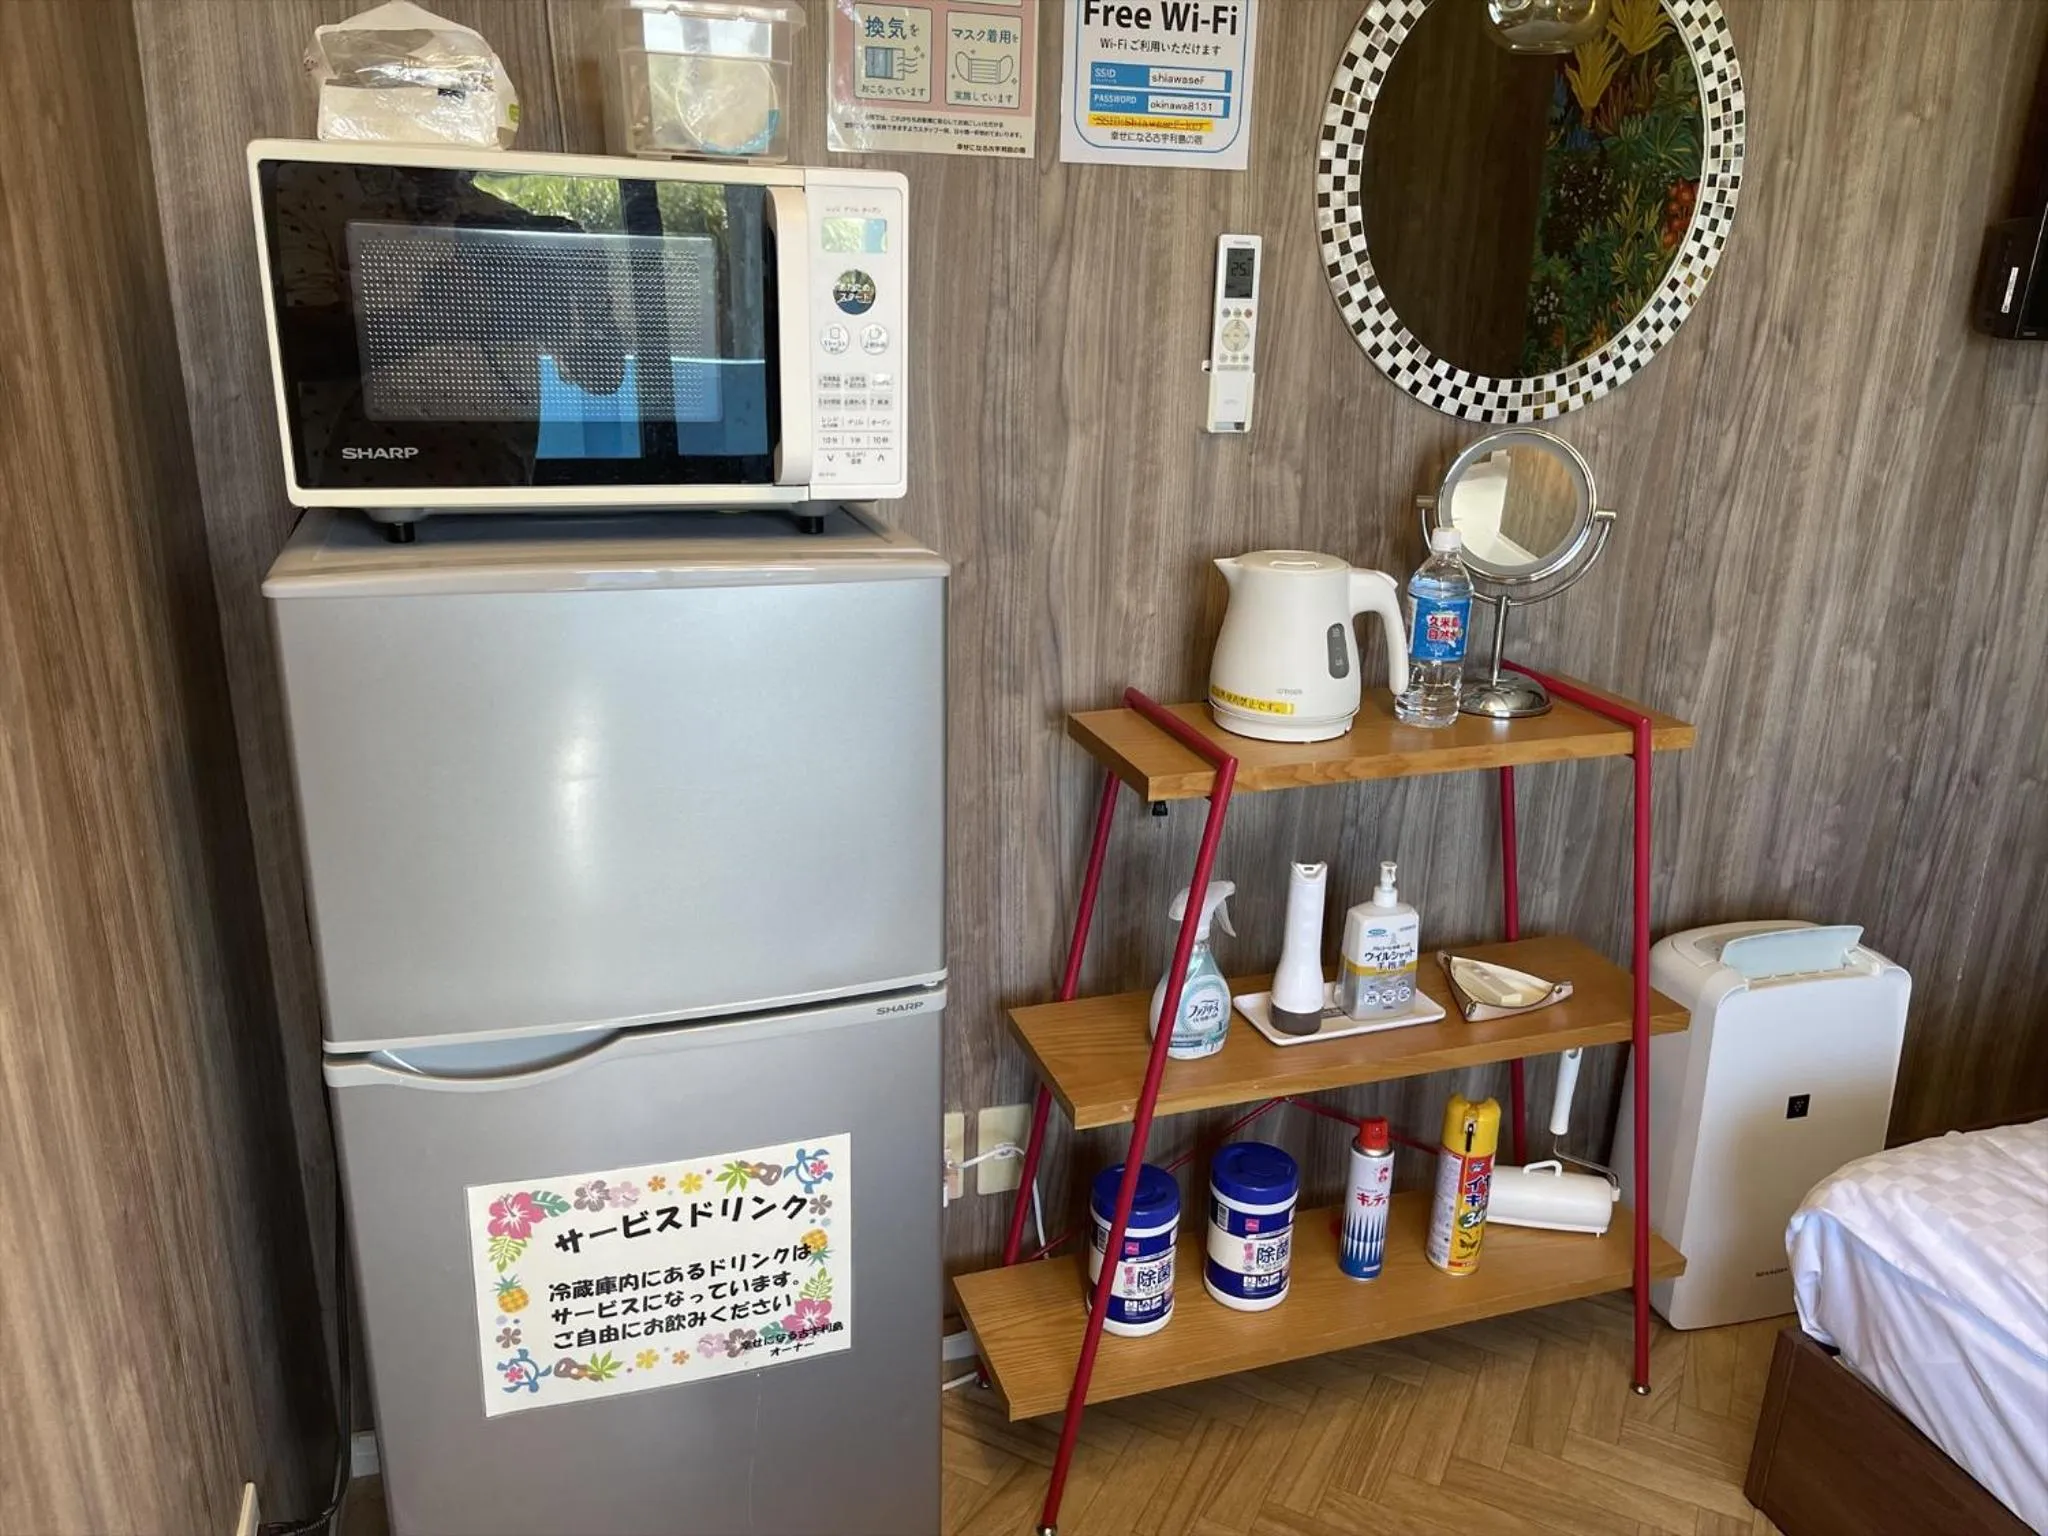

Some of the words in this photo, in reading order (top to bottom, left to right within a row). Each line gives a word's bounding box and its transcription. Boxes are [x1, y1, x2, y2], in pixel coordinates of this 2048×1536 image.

[1084, 0, 1151, 30] Free
[1161, 1, 1238, 35] Wi-Fi
[865, 15, 920, 40] 換気を
[952, 27, 1019, 45] マスク着用を
[1100, 37, 1128, 50] Wi-Fi
[1131, 39, 1222, 56] ご利用いただけます
[1094, 68, 1116, 78] SSID
[861, 84, 926, 97] おこなっています
[1094, 94, 1137, 105] PASSWORD
[1151, 101, 1213, 112] okinawa8131
[342, 447, 420, 460] SHARP
[876, 1001, 924, 1016] SHARP
[554, 1194, 808, 1254] サービスドリンク
[548, 1243, 812, 1303] 冷蔵庫内にあるドリンクは
[551, 1270, 800, 1325] サービスになっています。
[553, 1294, 792, 1350] ご自由にお飲みください
[770, 1342, 815, 1357] オーナー
